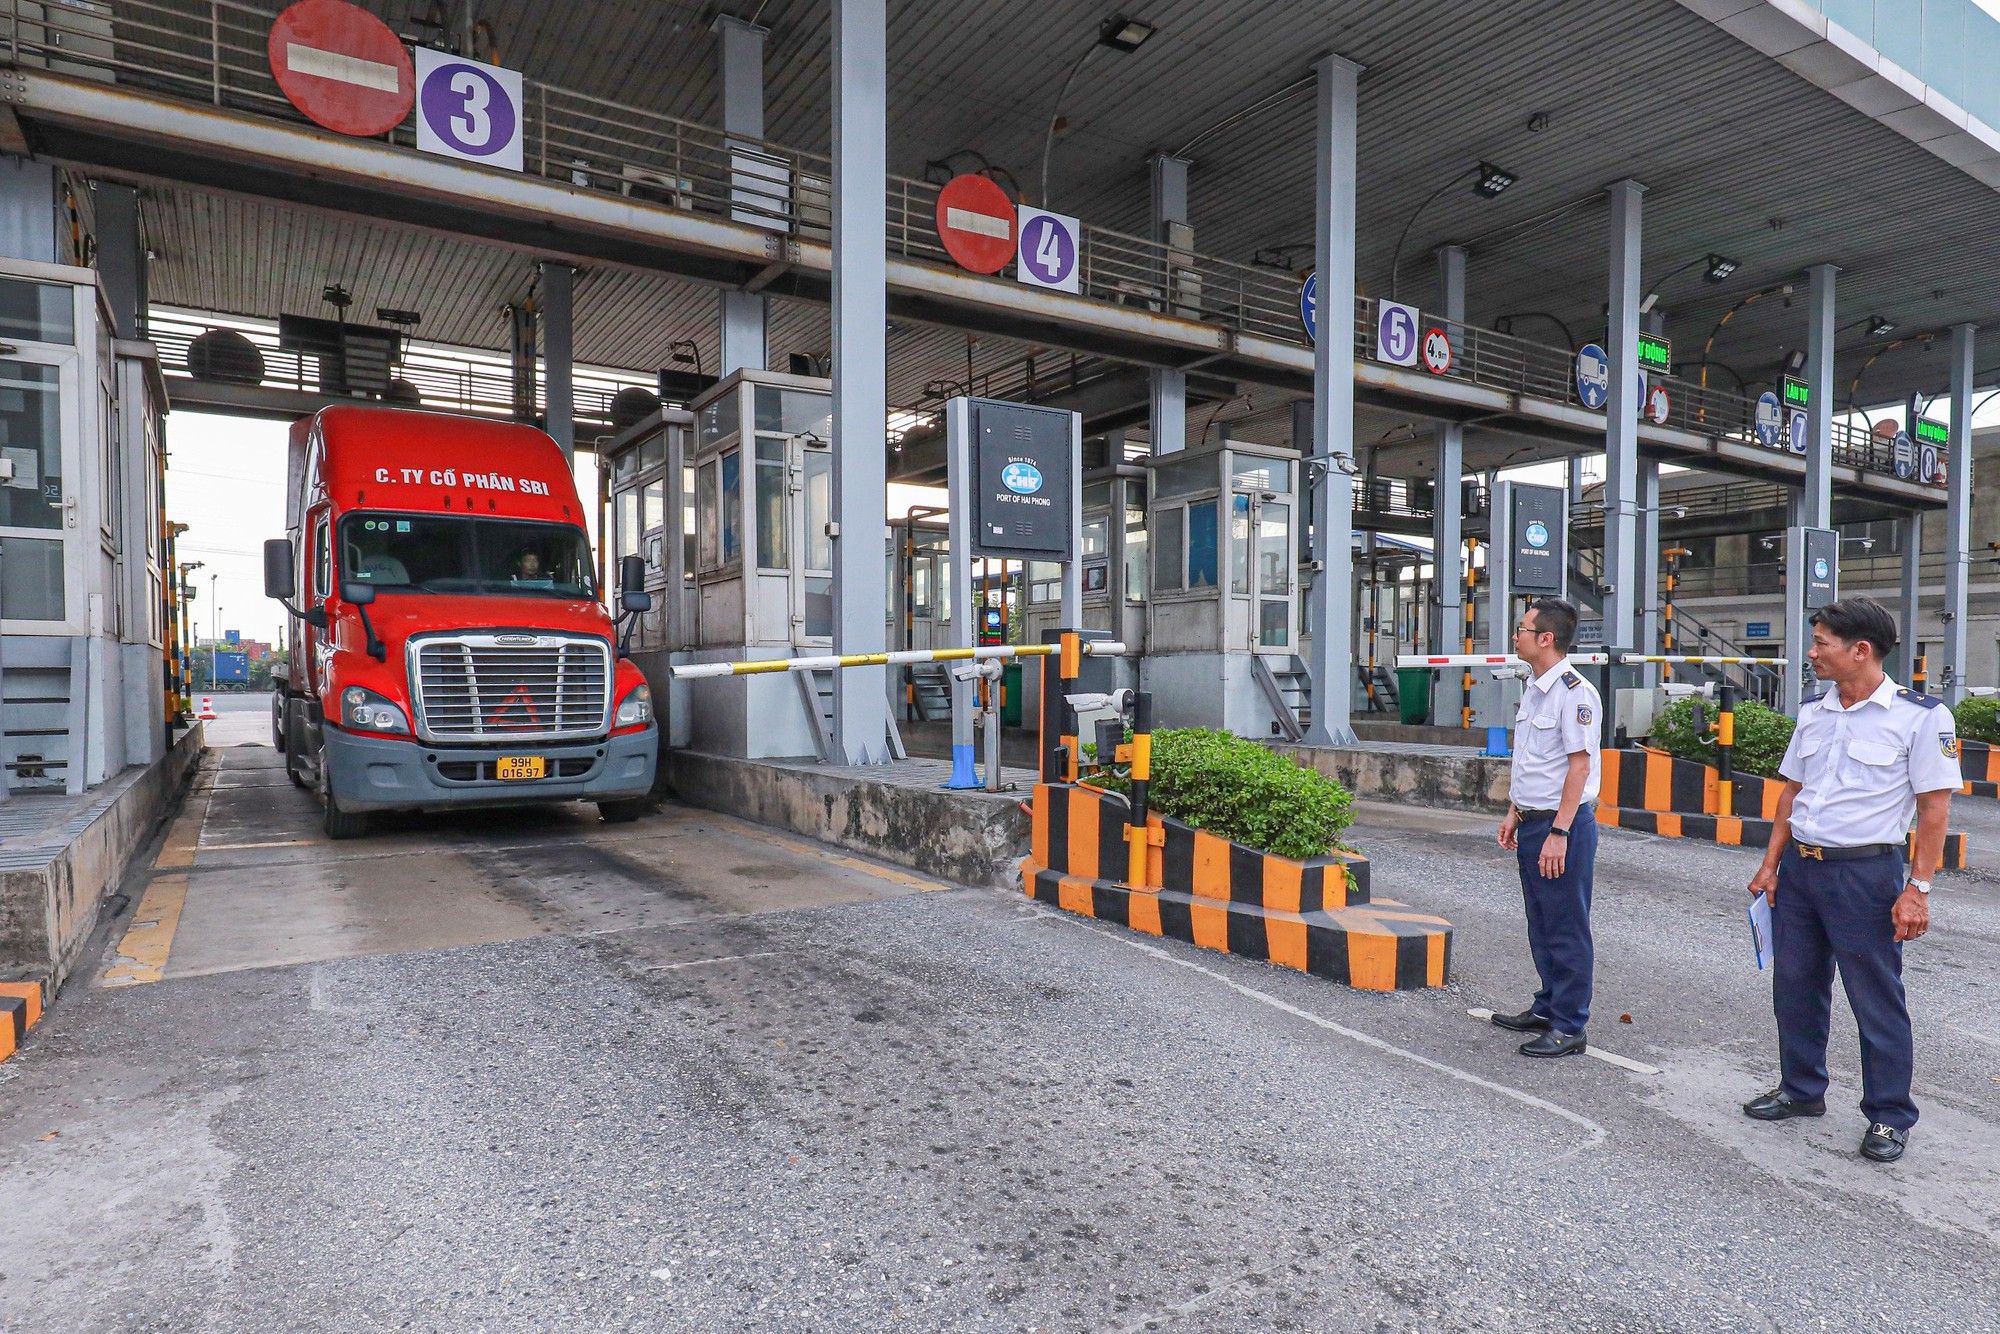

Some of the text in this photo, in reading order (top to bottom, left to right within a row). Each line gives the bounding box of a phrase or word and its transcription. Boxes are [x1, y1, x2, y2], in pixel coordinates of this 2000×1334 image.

[450, 71, 491, 146] 3
[1036, 221, 1061, 278] 4
[1390, 311, 1407, 357] 5
[1796, 416, 1806, 448] 7
[1925, 450, 1932, 478] 8
[400, 469, 423, 484] TY
[519, 478, 550, 496] SBI
[996, 493, 1051, 507] PORT OF HAI PHONG
[502, 767, 540, 778] 016.97
[510, 757, 532, 768] 99H
